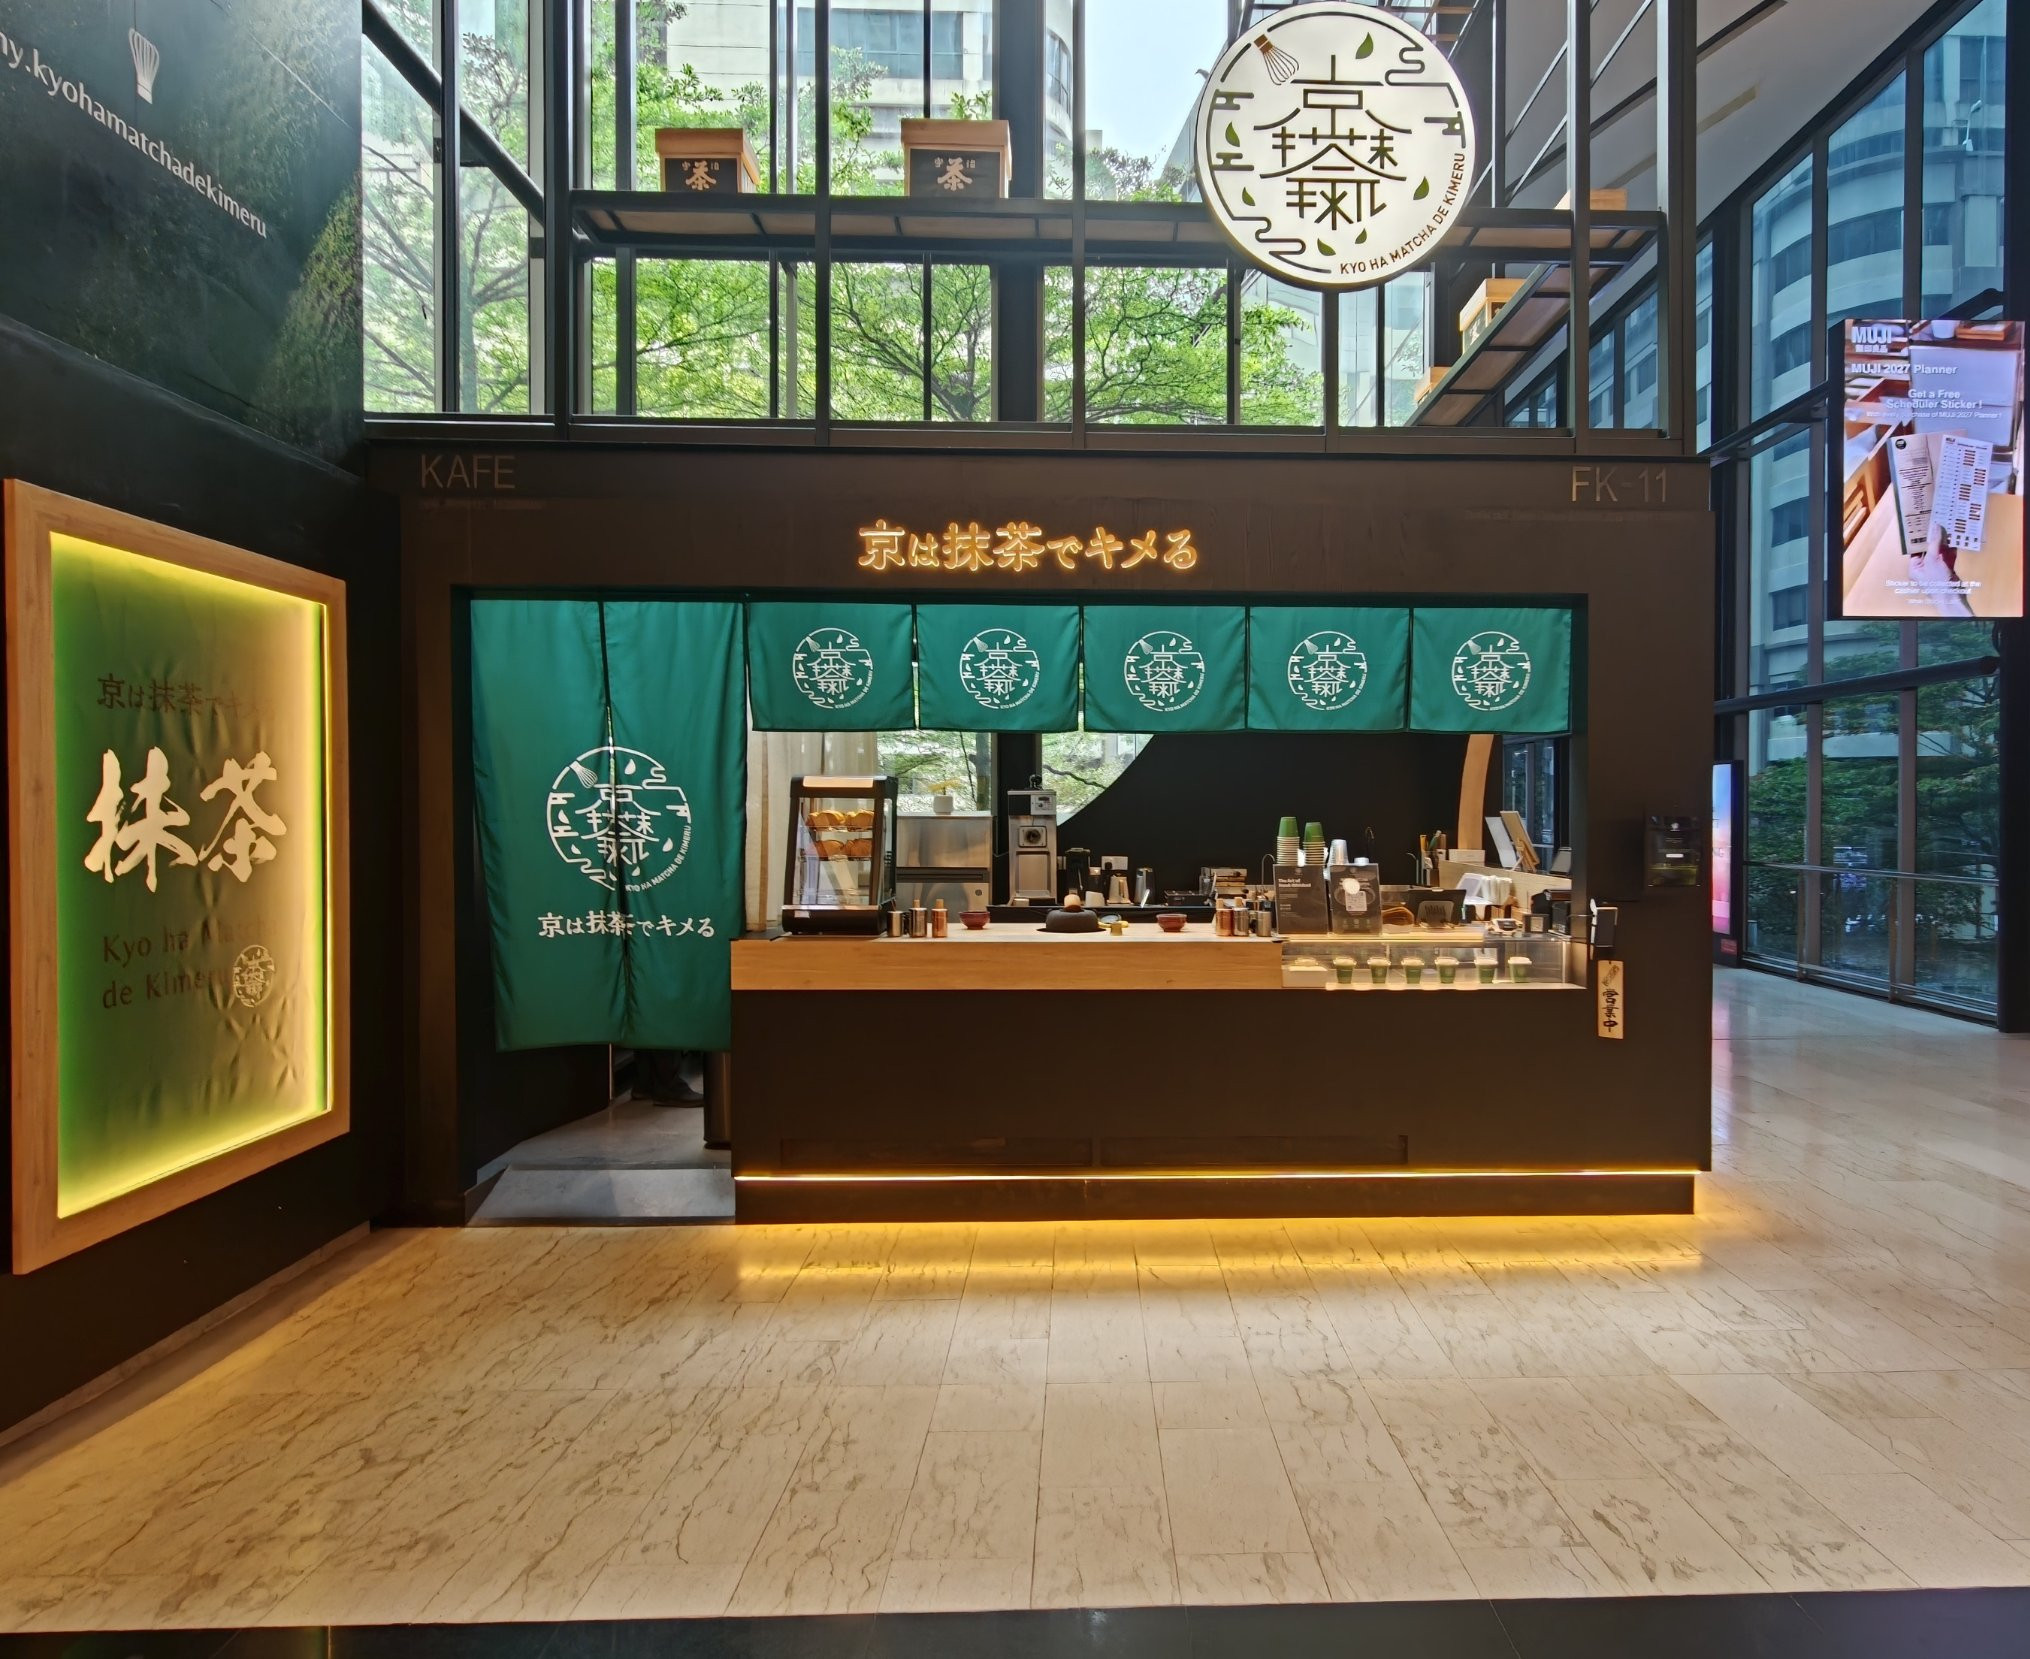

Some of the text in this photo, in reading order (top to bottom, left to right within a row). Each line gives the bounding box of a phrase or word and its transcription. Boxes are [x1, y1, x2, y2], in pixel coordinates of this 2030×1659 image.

[1340, 153, 1466, 275] KYO HA MATCHA DE KIMERU
[1851, 326, 1892, 344] MUJI
[1851, 363, 1958, 375] MUJI 2027 Planner
[1886, 400, 1939, 409] Scheduler
[1908, 389, 1926, 398] Get
[1938, 389, 1961, 398] Free
[421, 454, 516, 489] KAFE
[1571, 466, 1667, 502] FK-11
[858, 519, 1198, 572] 京は抹茶でキメる
[84, 746, 287, 892] 抹茶
[537, 910, 715, 938] 京は抹茶でキメる
[102, 934, 152, 968] Kyo
[102, 980, 132, 1009] de
